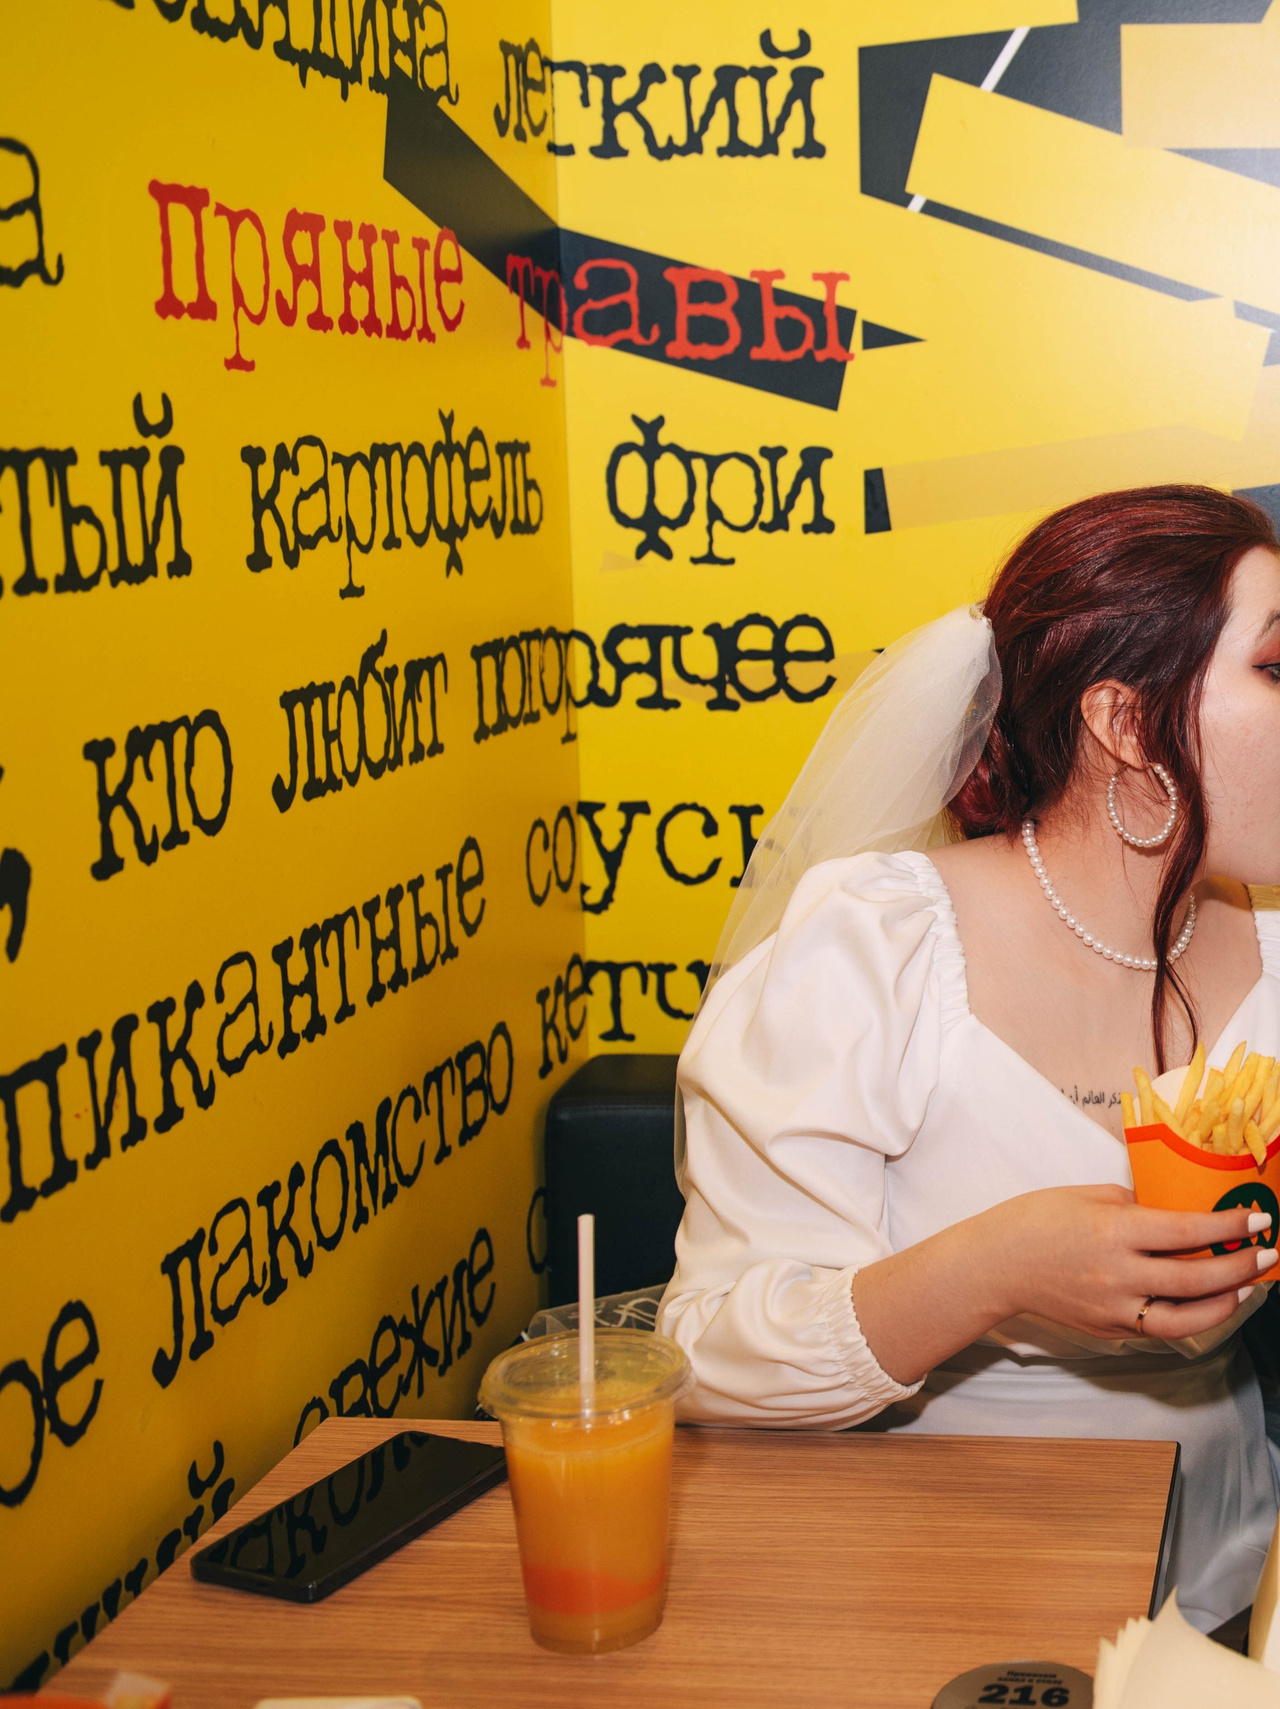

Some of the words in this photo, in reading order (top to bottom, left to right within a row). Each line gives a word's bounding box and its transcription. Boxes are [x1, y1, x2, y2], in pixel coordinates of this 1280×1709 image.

[494, 28, 826, 161] легкий
[506, 253, 855, 387] травы
[0, 392, 192, 596] тый
[241, 408, 543, 599] картофель
[606, 413, 835, 565] фри
[83, 708, 233, 881] кто
[272, 628, 447, 814] любит
[472, 613, 837, 743] погорячее
[0, 836, 486, 1223] пикантные
[0, 1299, 104, 1508] ое
[153, 1021, 514, 1389] лакомство
[978, 1683, 1070, 1707] 216
